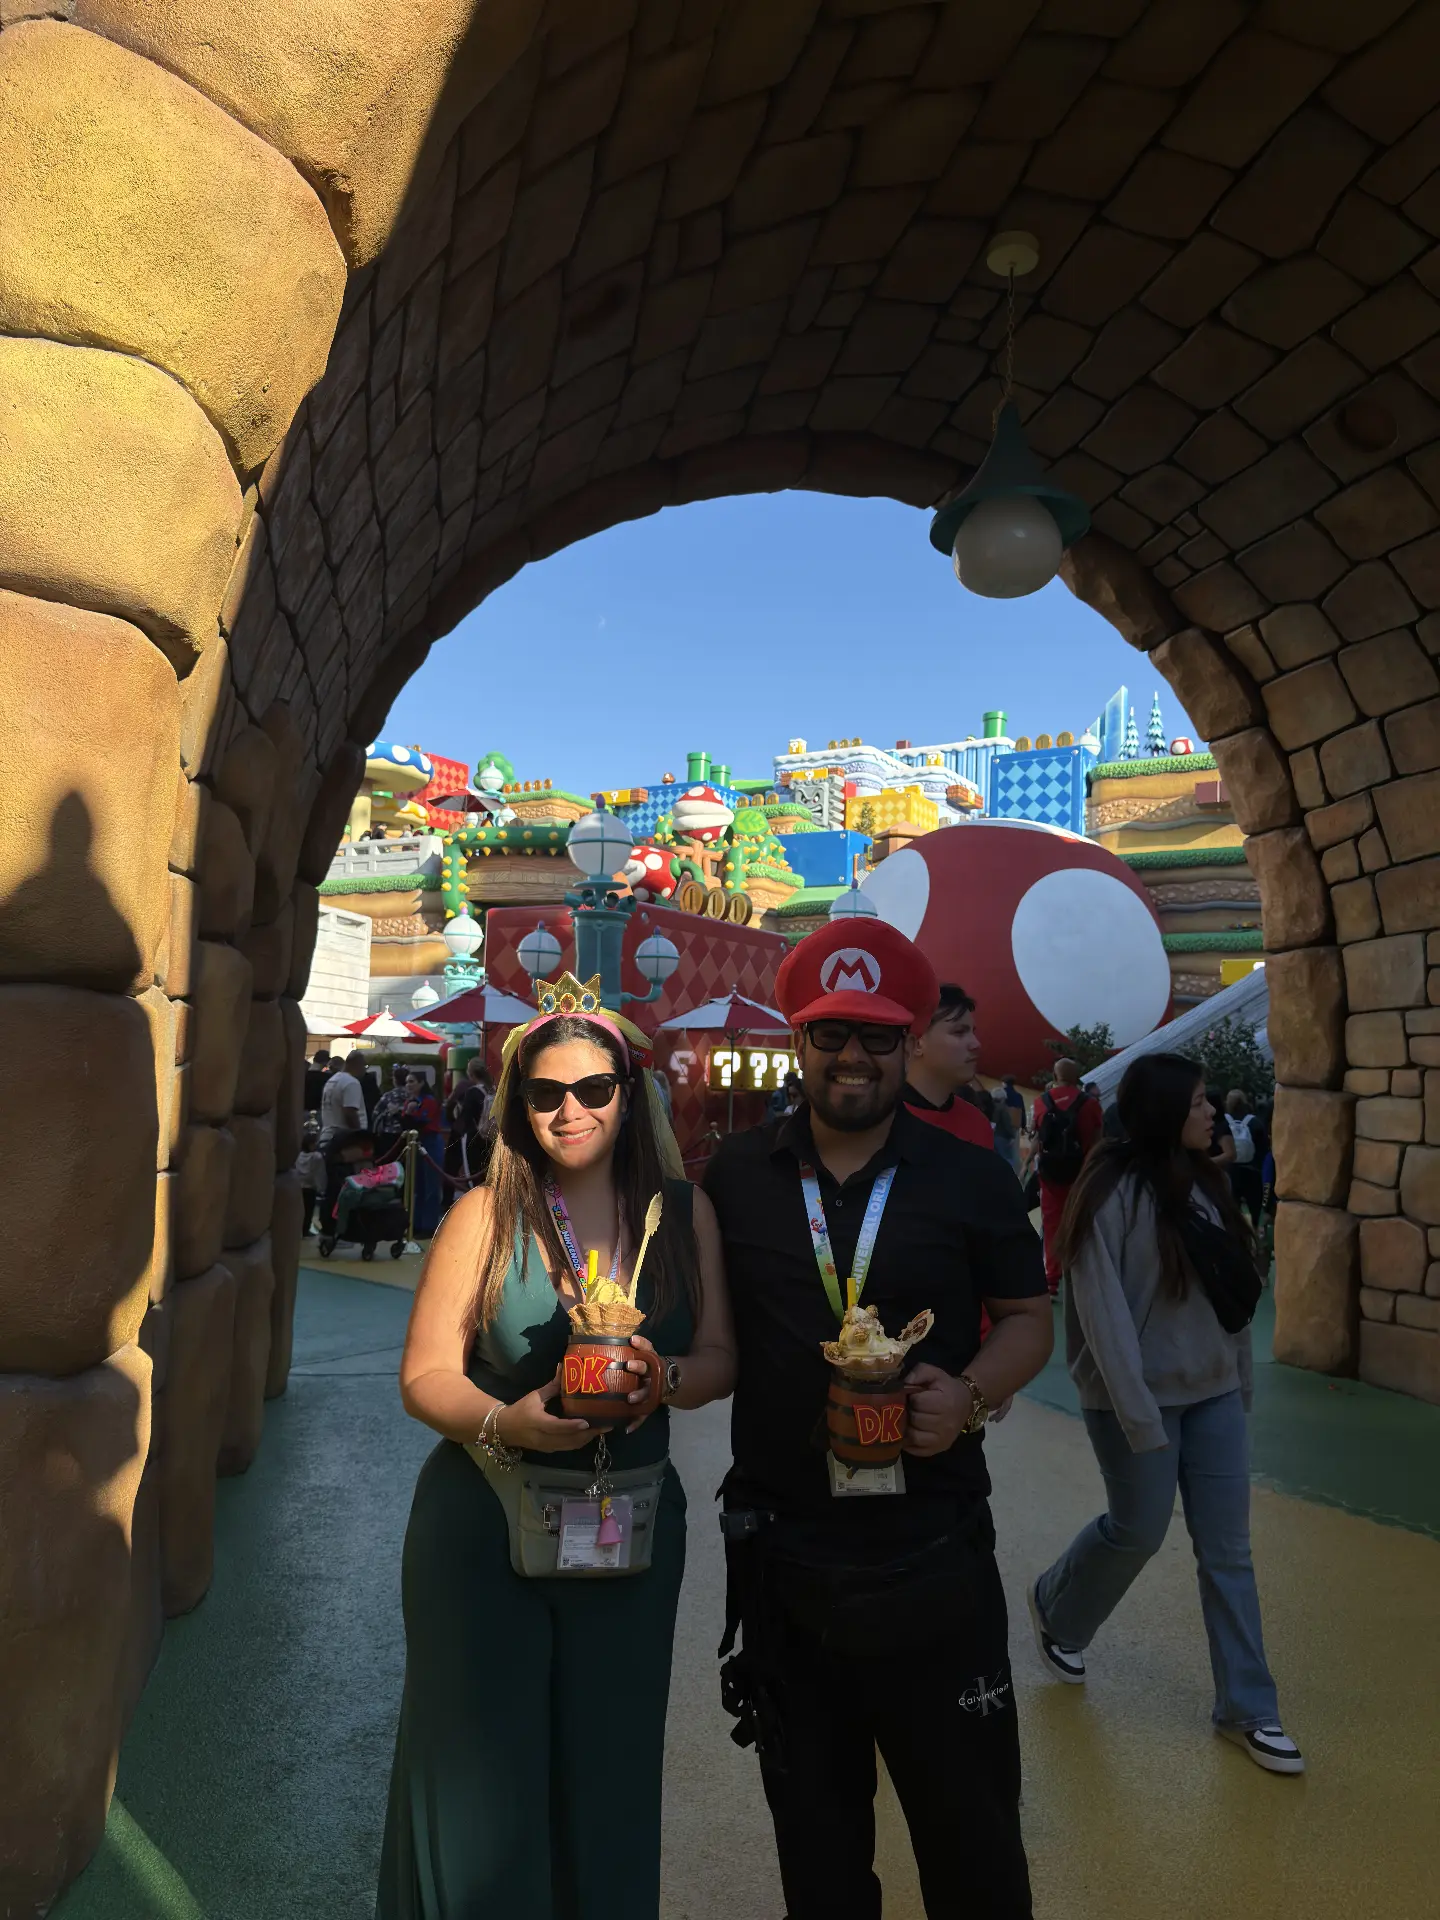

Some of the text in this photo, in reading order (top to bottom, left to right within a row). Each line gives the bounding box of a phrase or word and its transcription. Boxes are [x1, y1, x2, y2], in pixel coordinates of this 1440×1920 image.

[825, 956, 876, 993] M
[552, 1204, 568, 1232] SUPER
[562, 1229, 581, 1271] NINTENDO
[563, 1354, 612, 1395] DK
[853, 1403, 905, 1446] DK
[957, 1692, 991, 1707] Calvin
